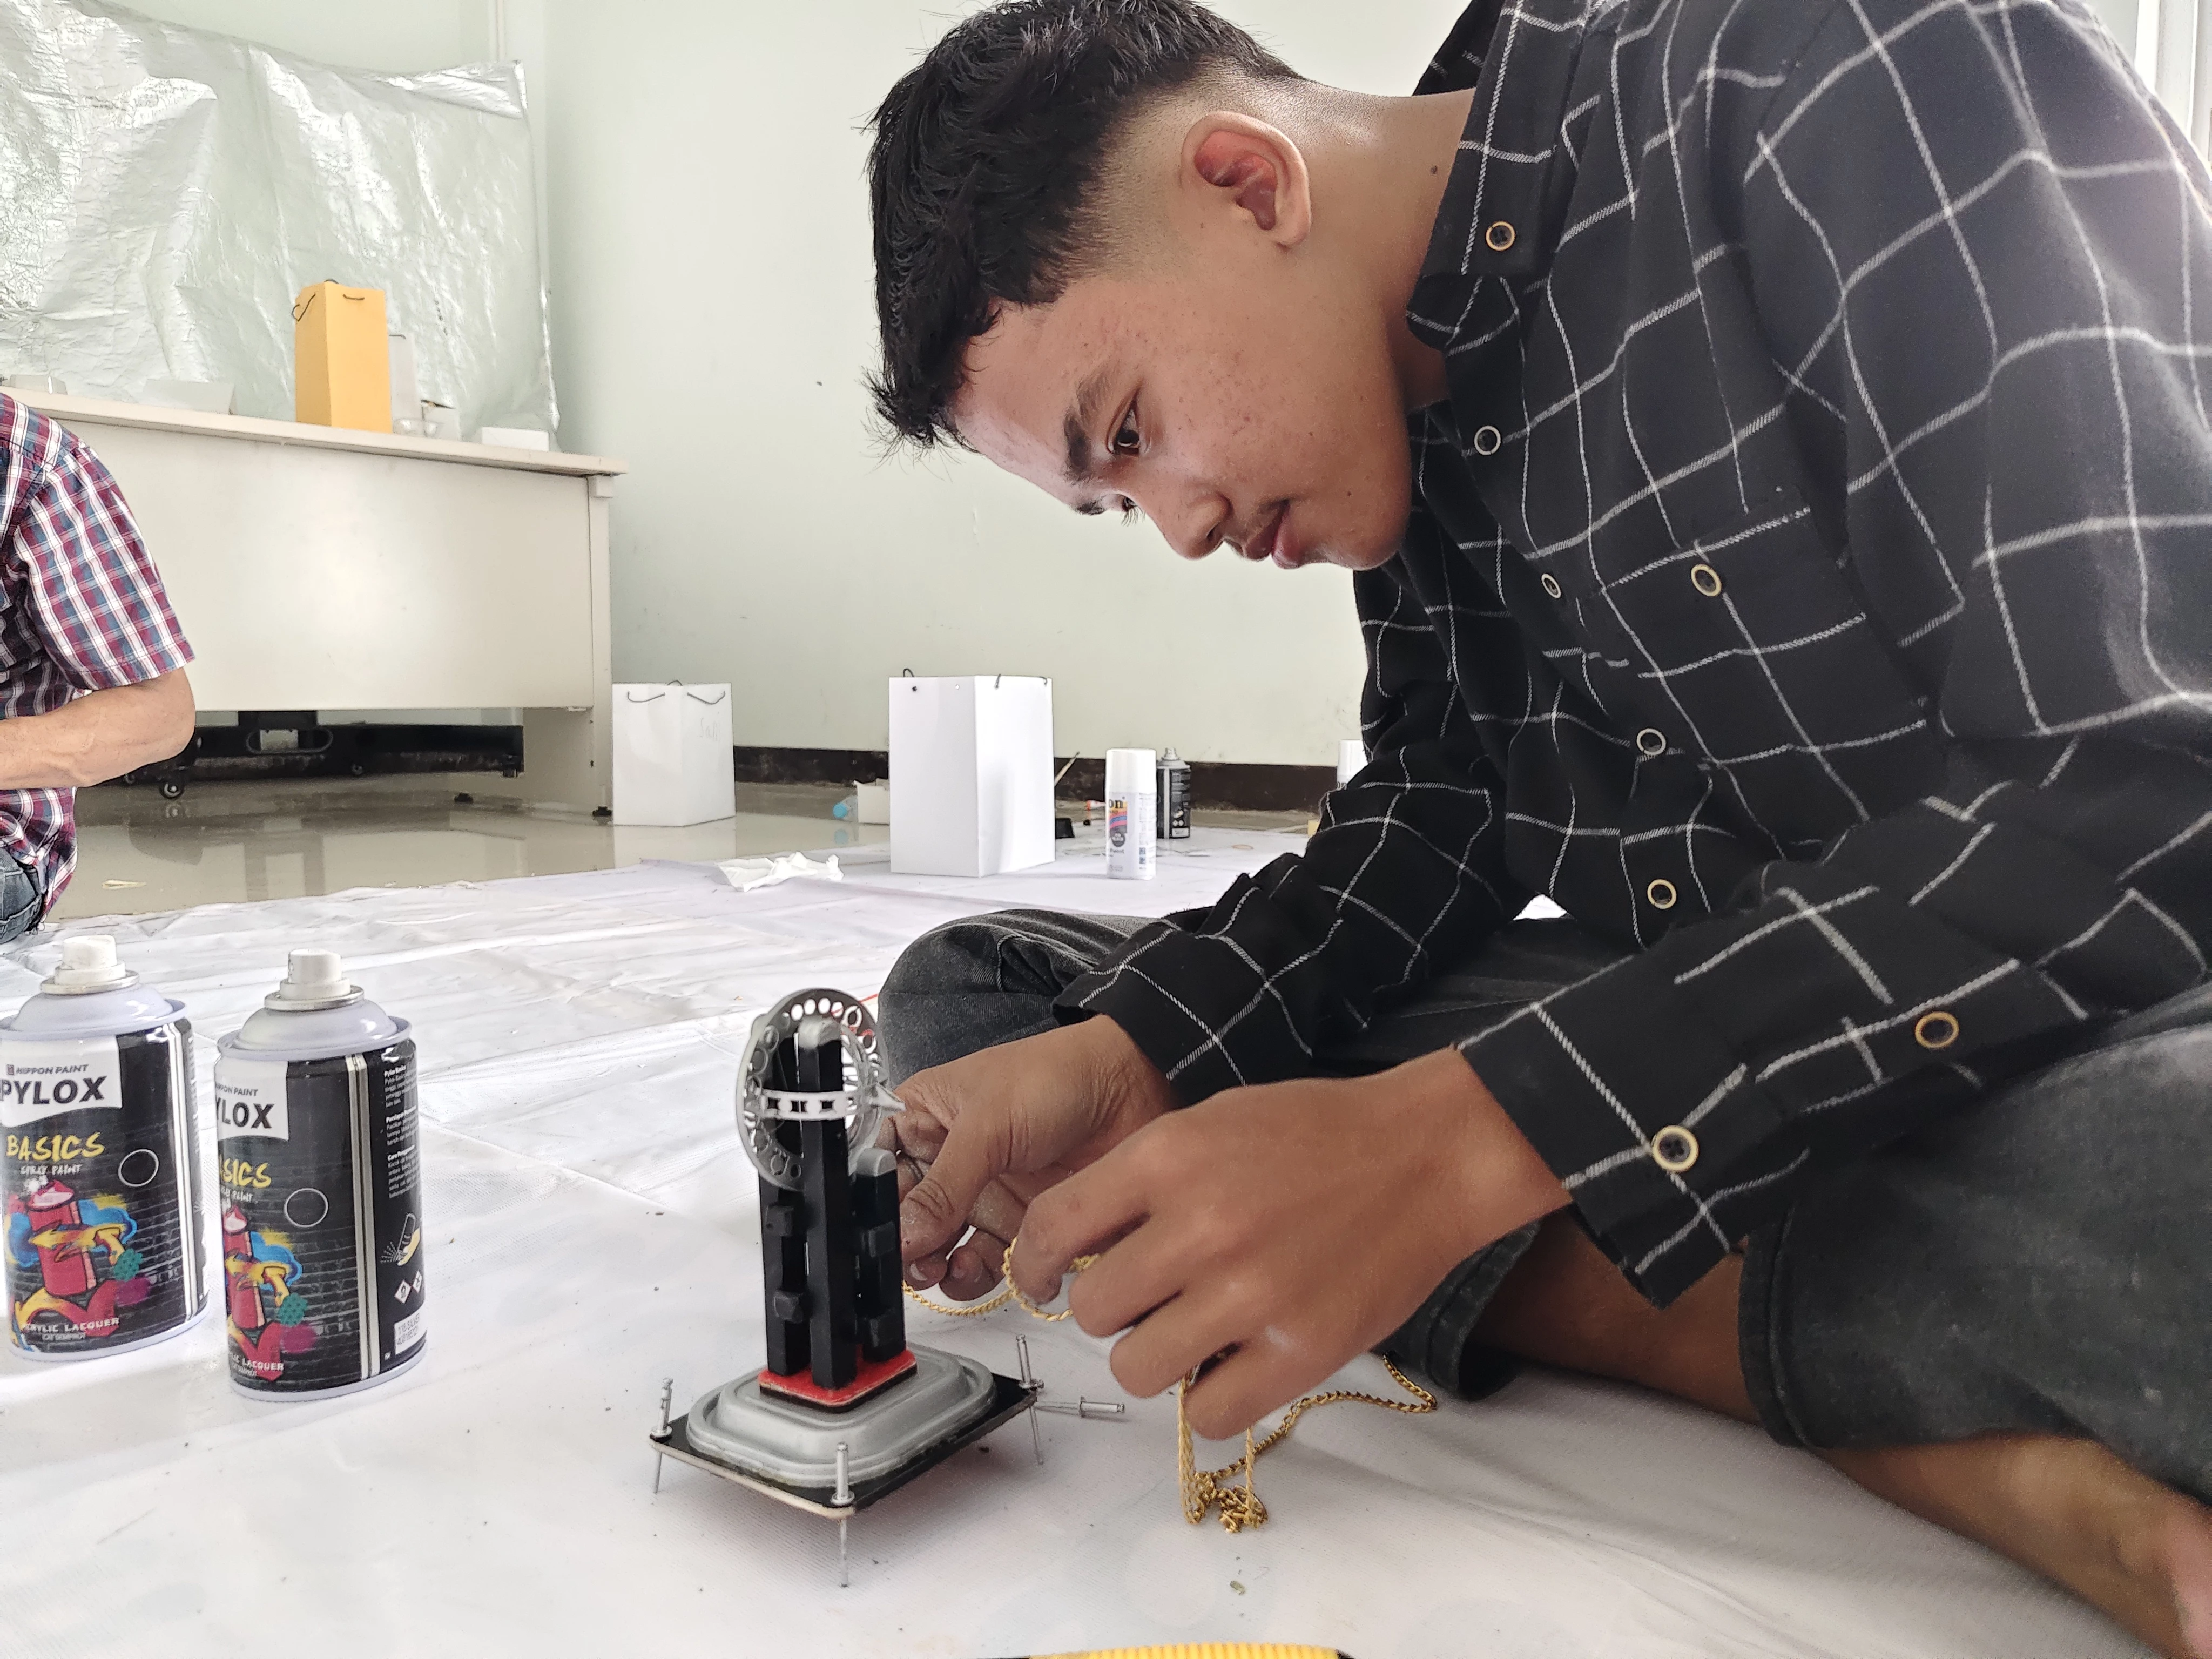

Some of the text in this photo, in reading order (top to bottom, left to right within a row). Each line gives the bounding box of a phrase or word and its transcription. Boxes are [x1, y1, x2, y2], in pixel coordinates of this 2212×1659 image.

[55, 1064, 89, 1074] PAINT
[1, 1076, 107, 1104] PYLOX
[234, 1087, 258, 1097] PAINT
[6, 1132, 105, 1162] BASICS
[51, 1164, 82, 1176] PAINT
[64, 1317, 119, 1332] LACQUER
[241, 1358, 285, 1371] LACQUER
